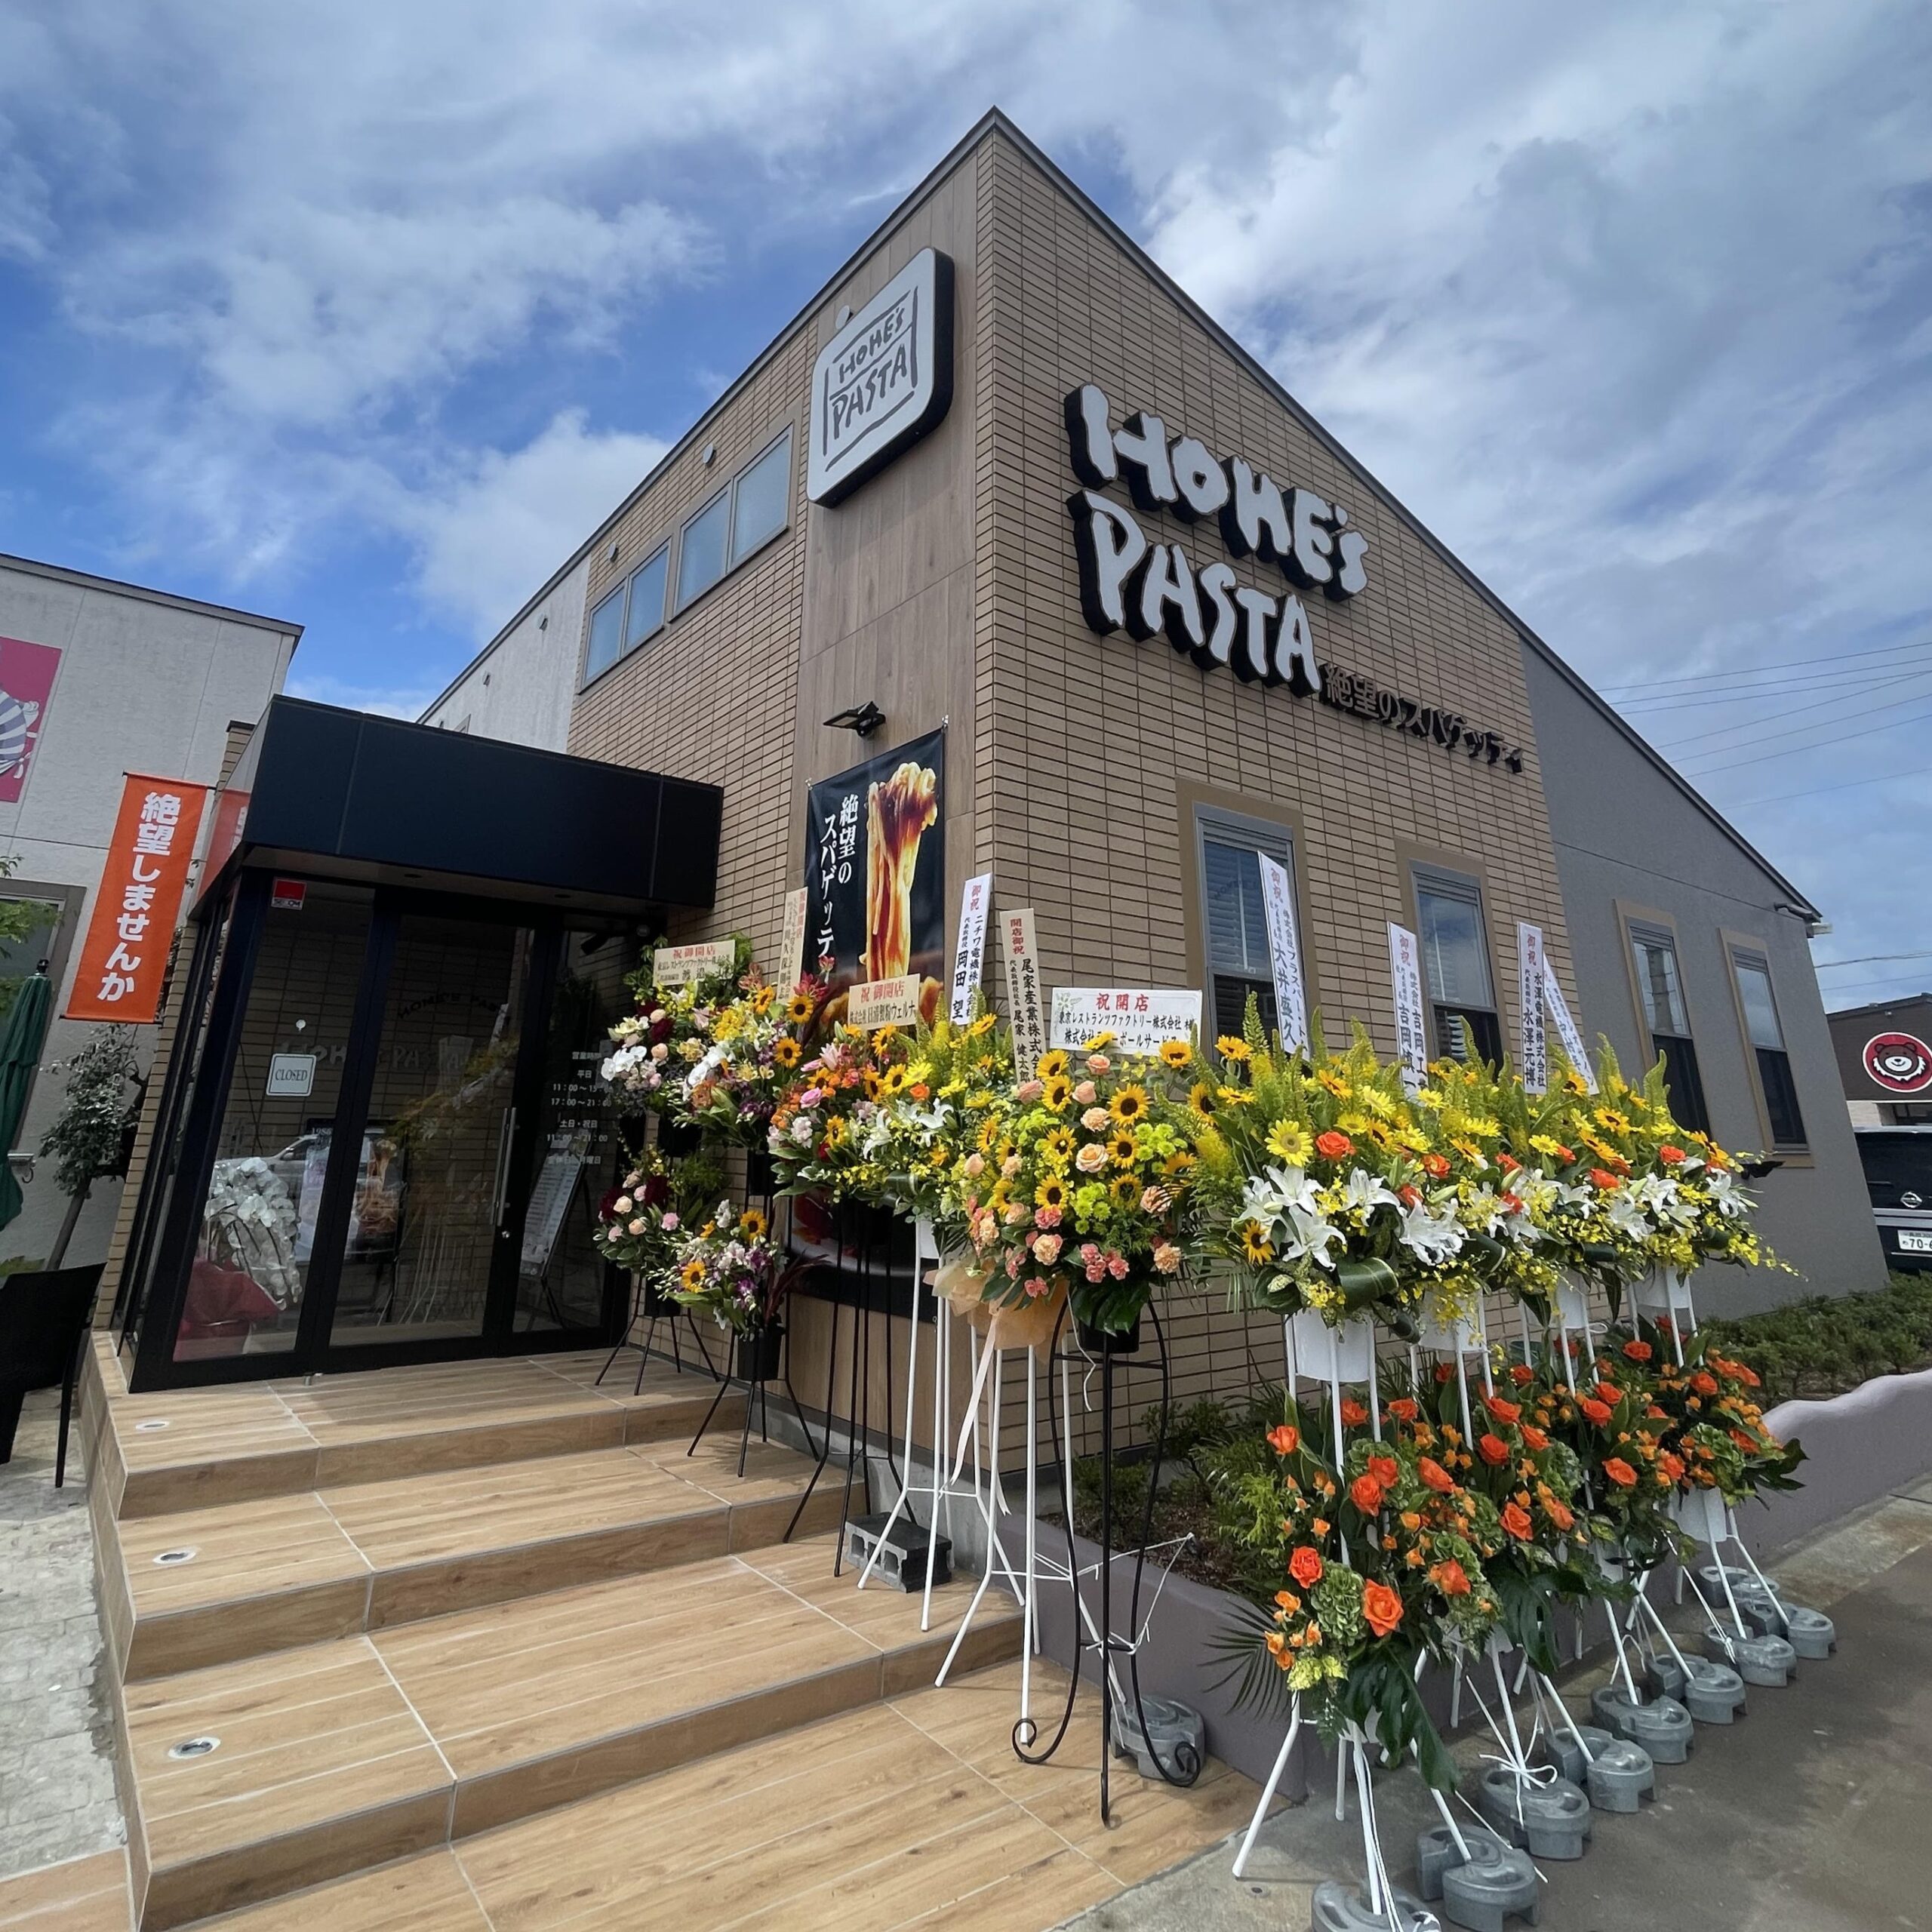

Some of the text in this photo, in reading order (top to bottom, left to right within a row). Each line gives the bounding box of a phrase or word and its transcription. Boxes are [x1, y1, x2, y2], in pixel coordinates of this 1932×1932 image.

[832, 343, 907, 440] PASTA
[1079, 488, 1322, 694] PASTA
[1321, 663, 1524, 773] 絶望のスパゲッティ
[838, 794, 859, 884] 絶望の
[97, 792, 182, 1001] 絶望しませんか
[970, 884, 982, 911] 御祝
[1010, 918, 1025, 955] 開店御祝
[952, 999, 964, 1020] 望
[1096, 992, 1149, 1012] 祝開店
[1014, 1010, 1026, 1036] 尾家
[275, 1068, 308, 1081] CLOSED
[577, 1070, 592, 1078] 平日
